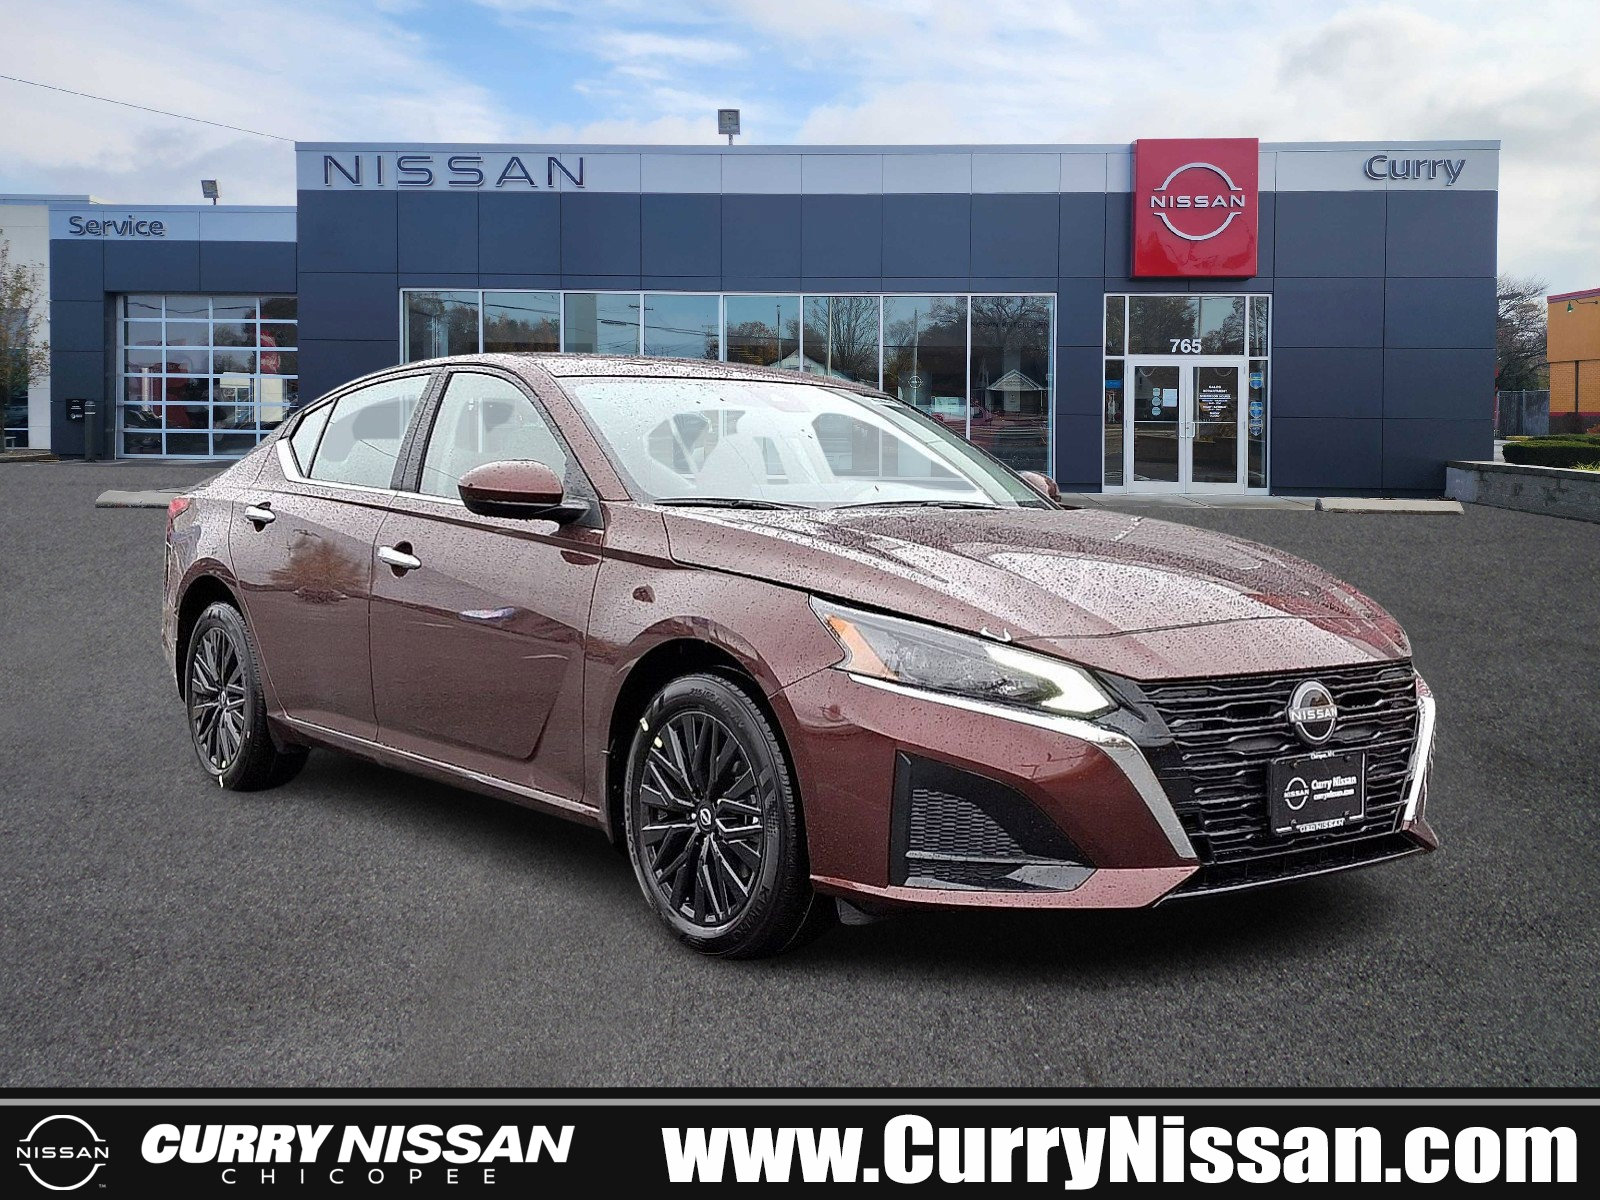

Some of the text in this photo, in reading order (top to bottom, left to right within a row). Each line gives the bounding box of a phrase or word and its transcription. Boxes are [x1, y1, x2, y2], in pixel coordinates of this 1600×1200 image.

[323, 154, 585, 188] NISSAN
[1364, 154, 1466, 187] Curry
[1150, 194, 1246, 208] NISSAN
[68, 213, 165, 237] Service
[1169, 338, 1202, 354] 765
[1290, 707, 1338, 721] NISSAN
[1311, 776, 1357, 791] Curry Nissan
[1283, 788, 1310, 798] NISSAN
